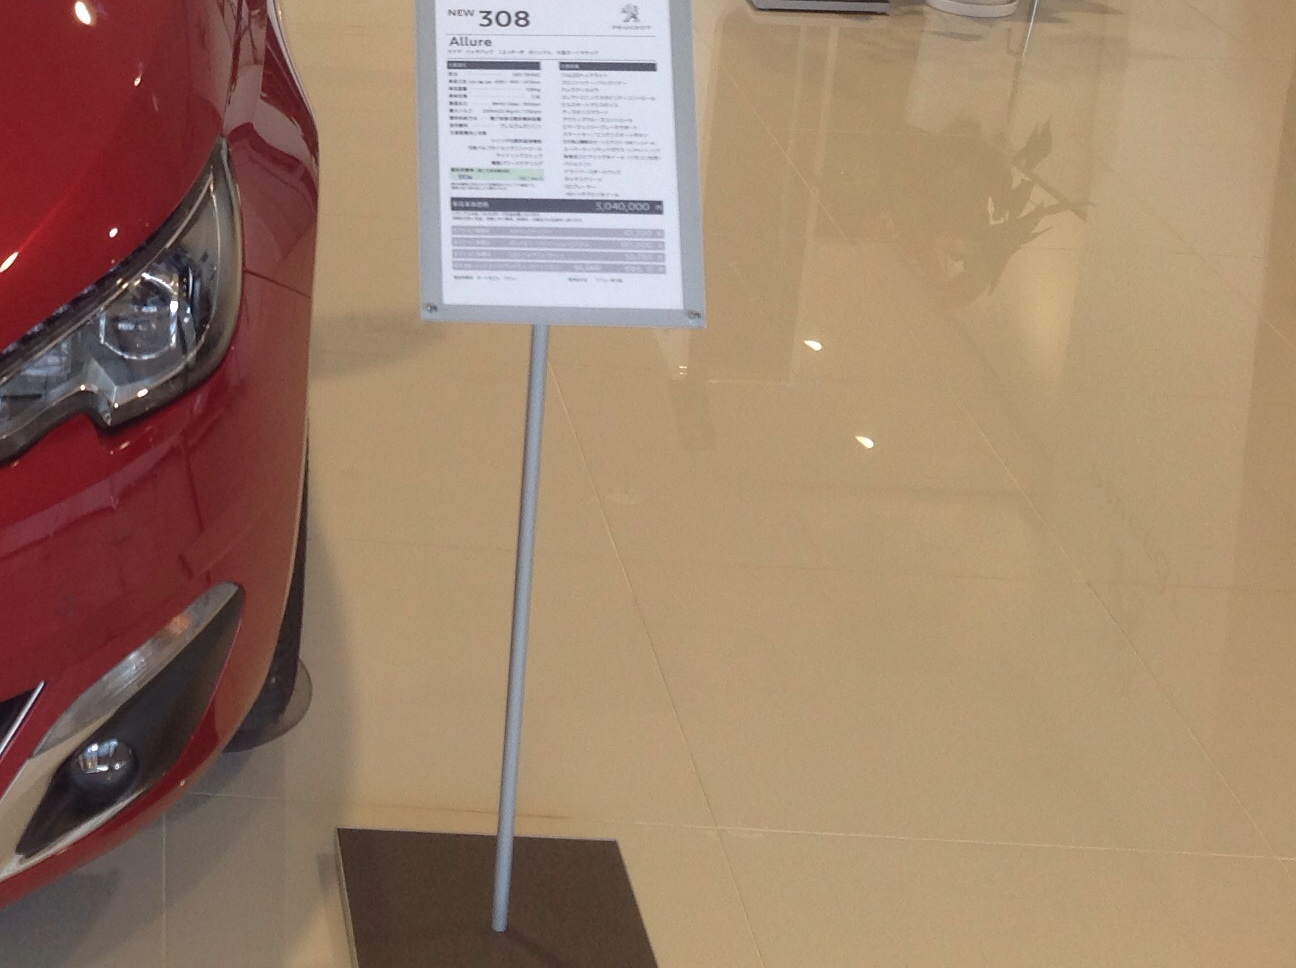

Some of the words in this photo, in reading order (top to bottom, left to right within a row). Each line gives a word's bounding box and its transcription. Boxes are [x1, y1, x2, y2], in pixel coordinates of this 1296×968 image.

[447, 9, 475, 17] NEW
[478, 10, 531, 28] 308
[449, 36, 493, 47] Allure
